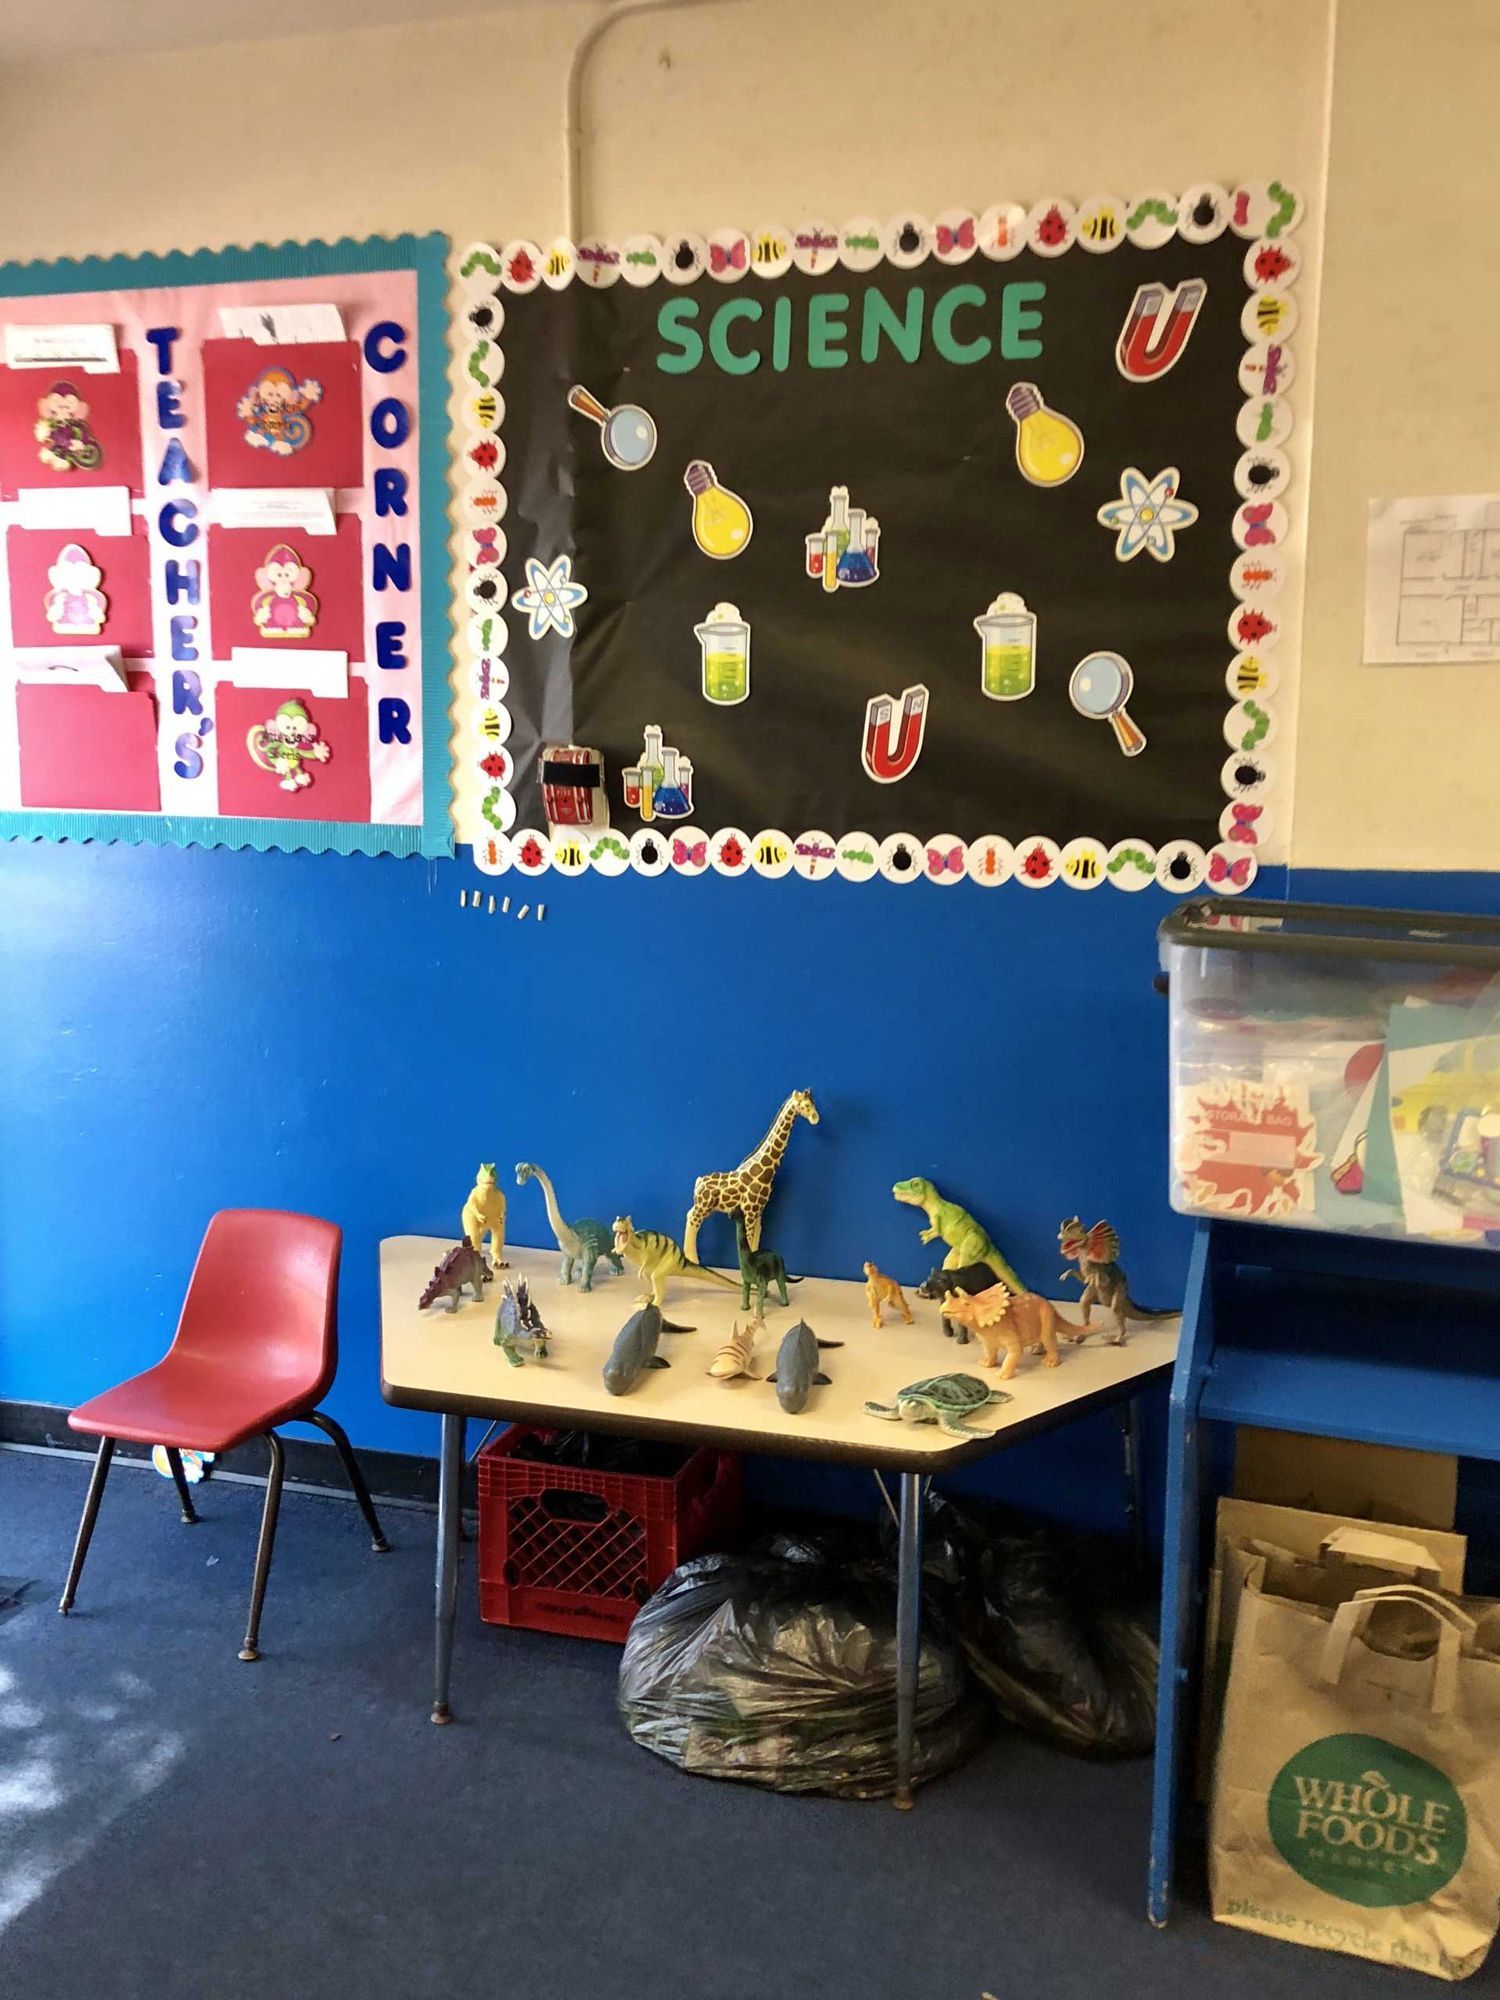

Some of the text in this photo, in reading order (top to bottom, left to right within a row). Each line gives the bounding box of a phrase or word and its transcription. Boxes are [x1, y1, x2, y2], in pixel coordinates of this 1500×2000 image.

[656, 281, 1047, 376] SCIENCE
[146, 326, 214, 780] TEACHER'S
[363, 320, 411, 745] CORNER
[1266, 1113, 1293, 1127] BAG
[1294, 1775, 1450, 1834] WHOLE
[1296, 1809, 1438, 1866] FOODS
[1227, 1897, 1297, 1930] please
[1303, 1917, 1384, 1952] recycle
[1389, 1935, 1433, 1966] this
